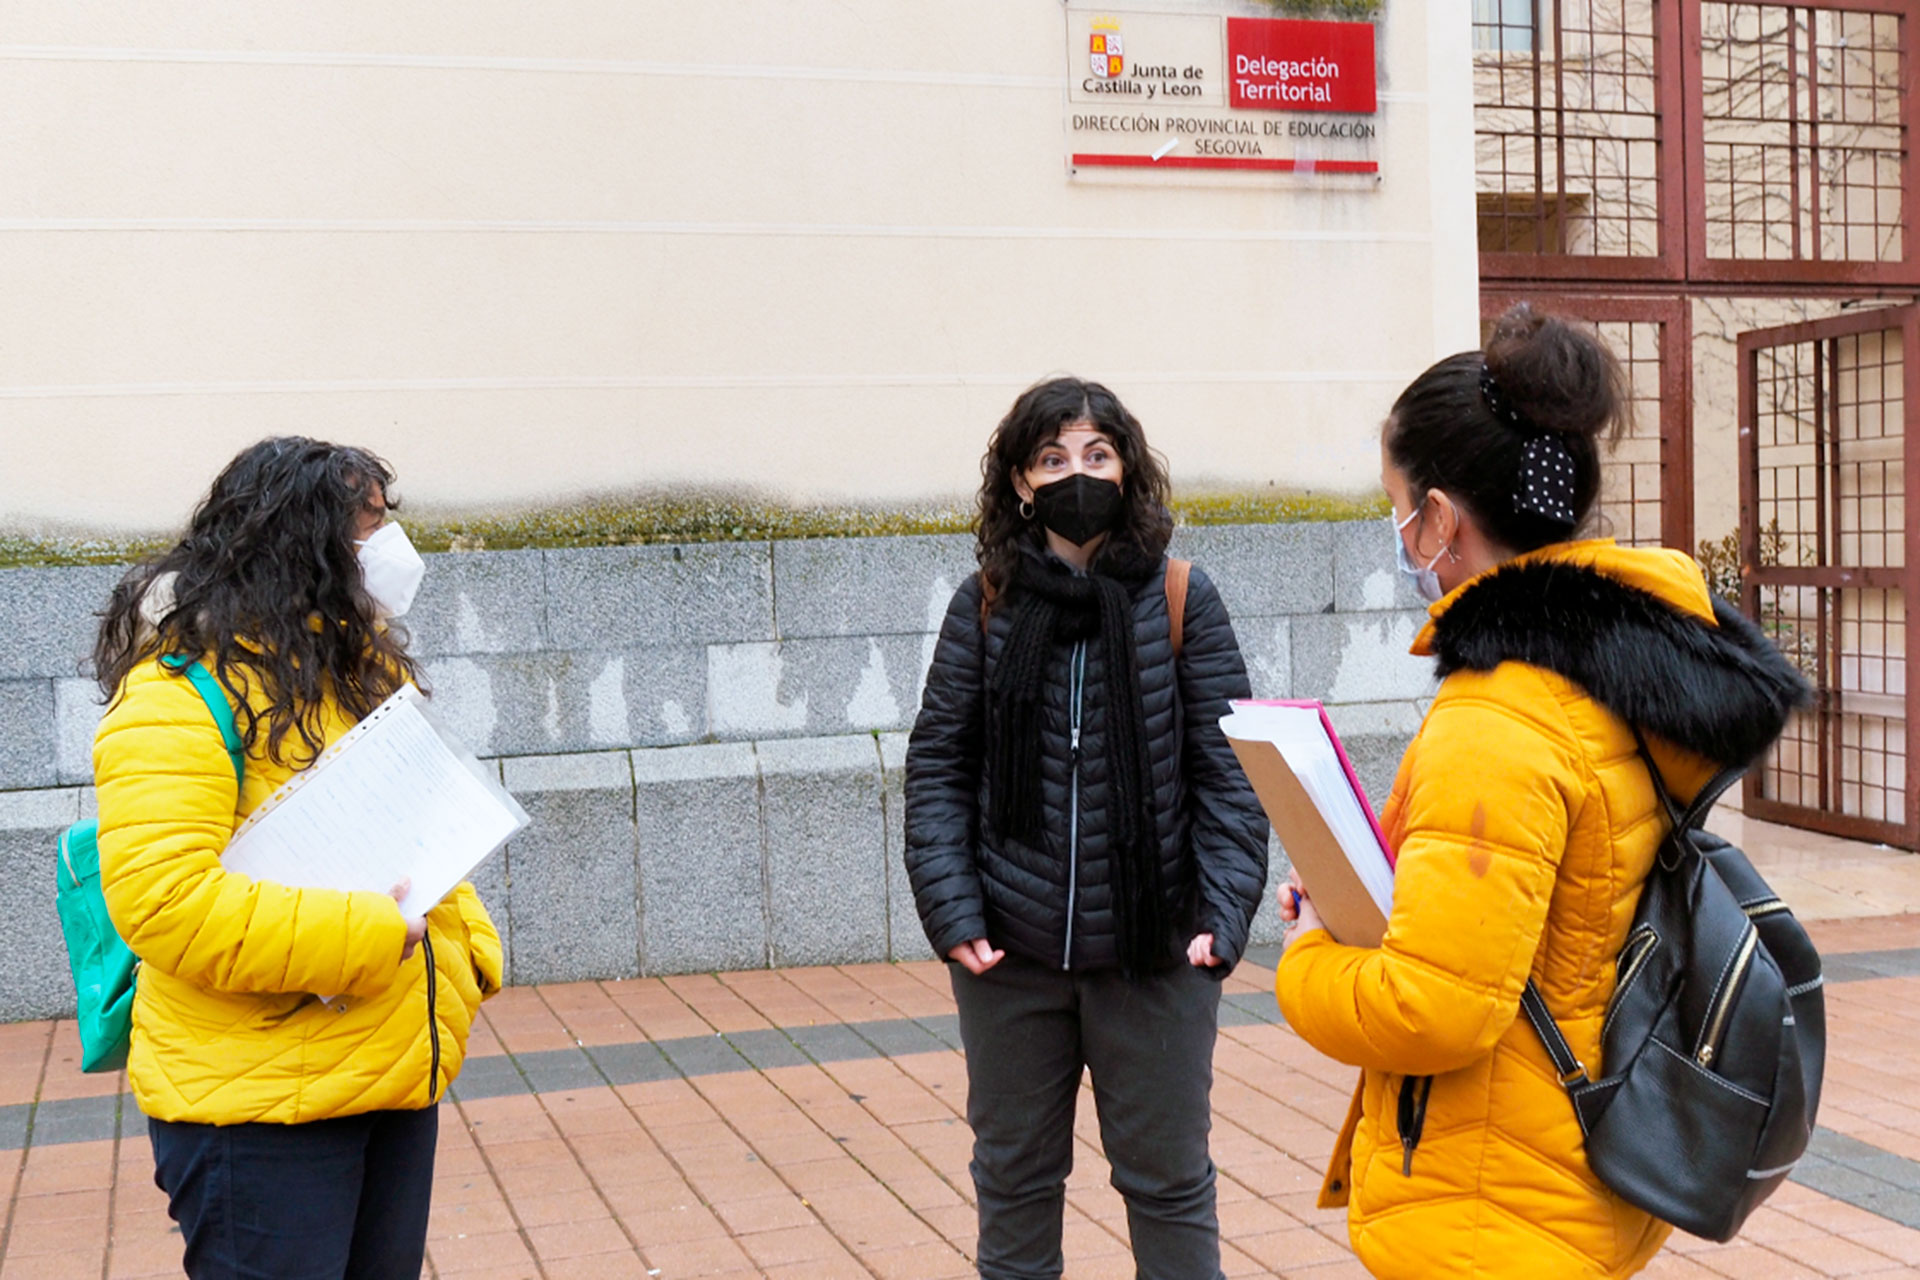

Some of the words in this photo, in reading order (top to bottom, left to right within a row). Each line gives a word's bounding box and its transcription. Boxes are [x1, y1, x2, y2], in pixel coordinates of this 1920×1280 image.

[1131, 63, 1177, 78] Junta
[1183, 65, 1203, 79] de
[1236, 54, 1339, 80] Delegación
[1082, 78, 1142, 94] Castilla
[1147, 84, 1157, 99] y
[1236, 79, 1331, 102] Territorial
[1073, 112, 1160, 132] DIRECCIÓN
[1166, 117, 1258, 135] PROVINCIAL
[1264, 120, 1282, 136] DE
[1288, 119, 1375, 138] EDUCACIÓN
[1195, 138, 1262, 155] SEGOVIA
